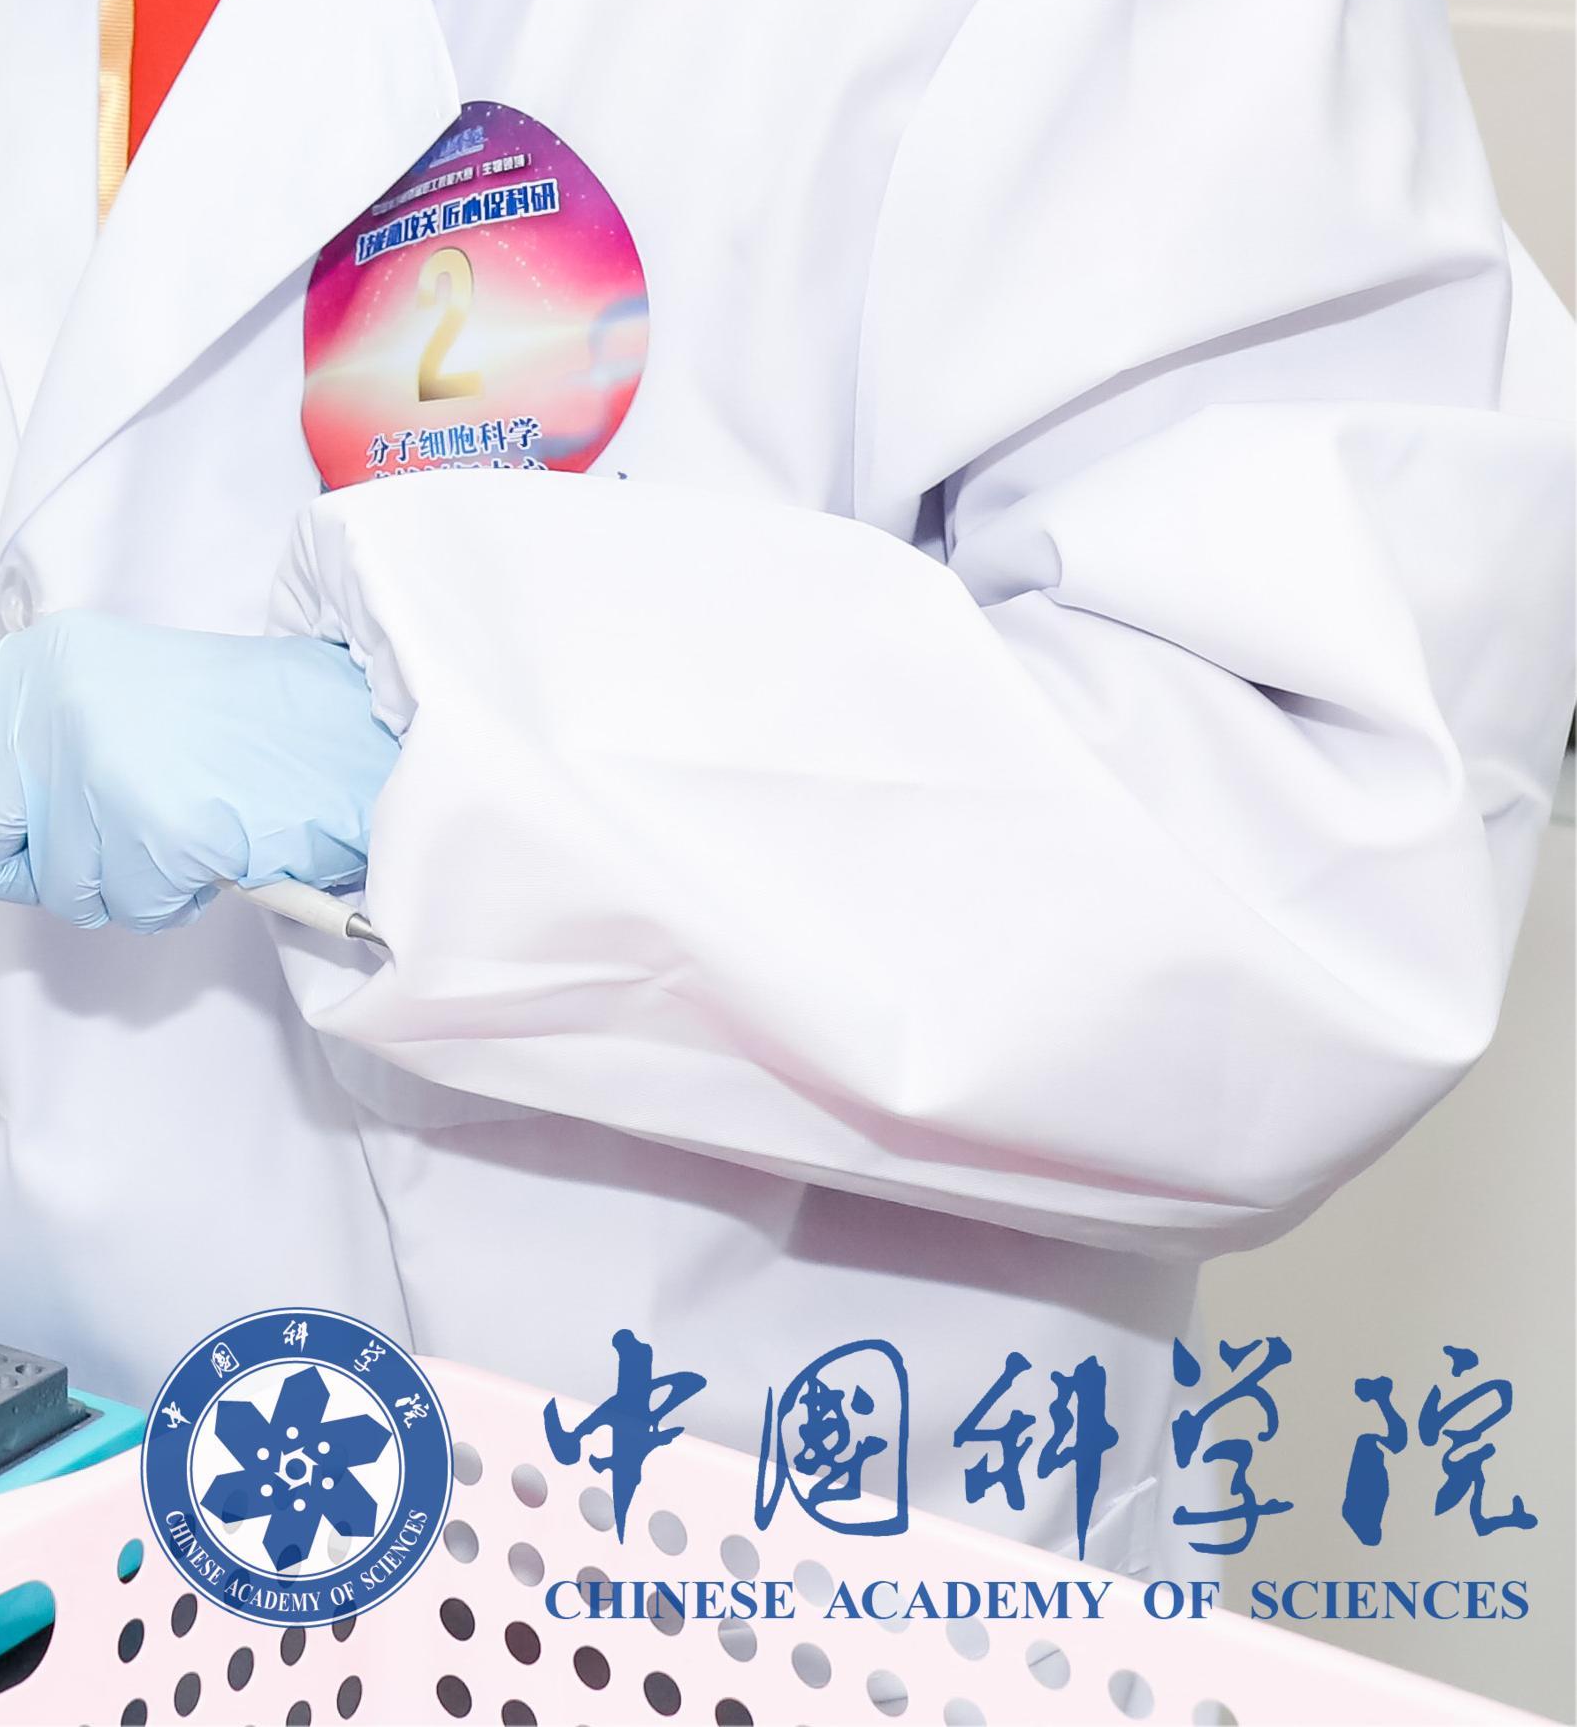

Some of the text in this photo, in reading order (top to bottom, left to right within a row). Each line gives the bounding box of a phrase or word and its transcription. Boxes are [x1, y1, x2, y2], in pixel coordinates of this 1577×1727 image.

[416, 245, 483, 402] 2
[366, 416, 540, 467] 分子细胞科学
